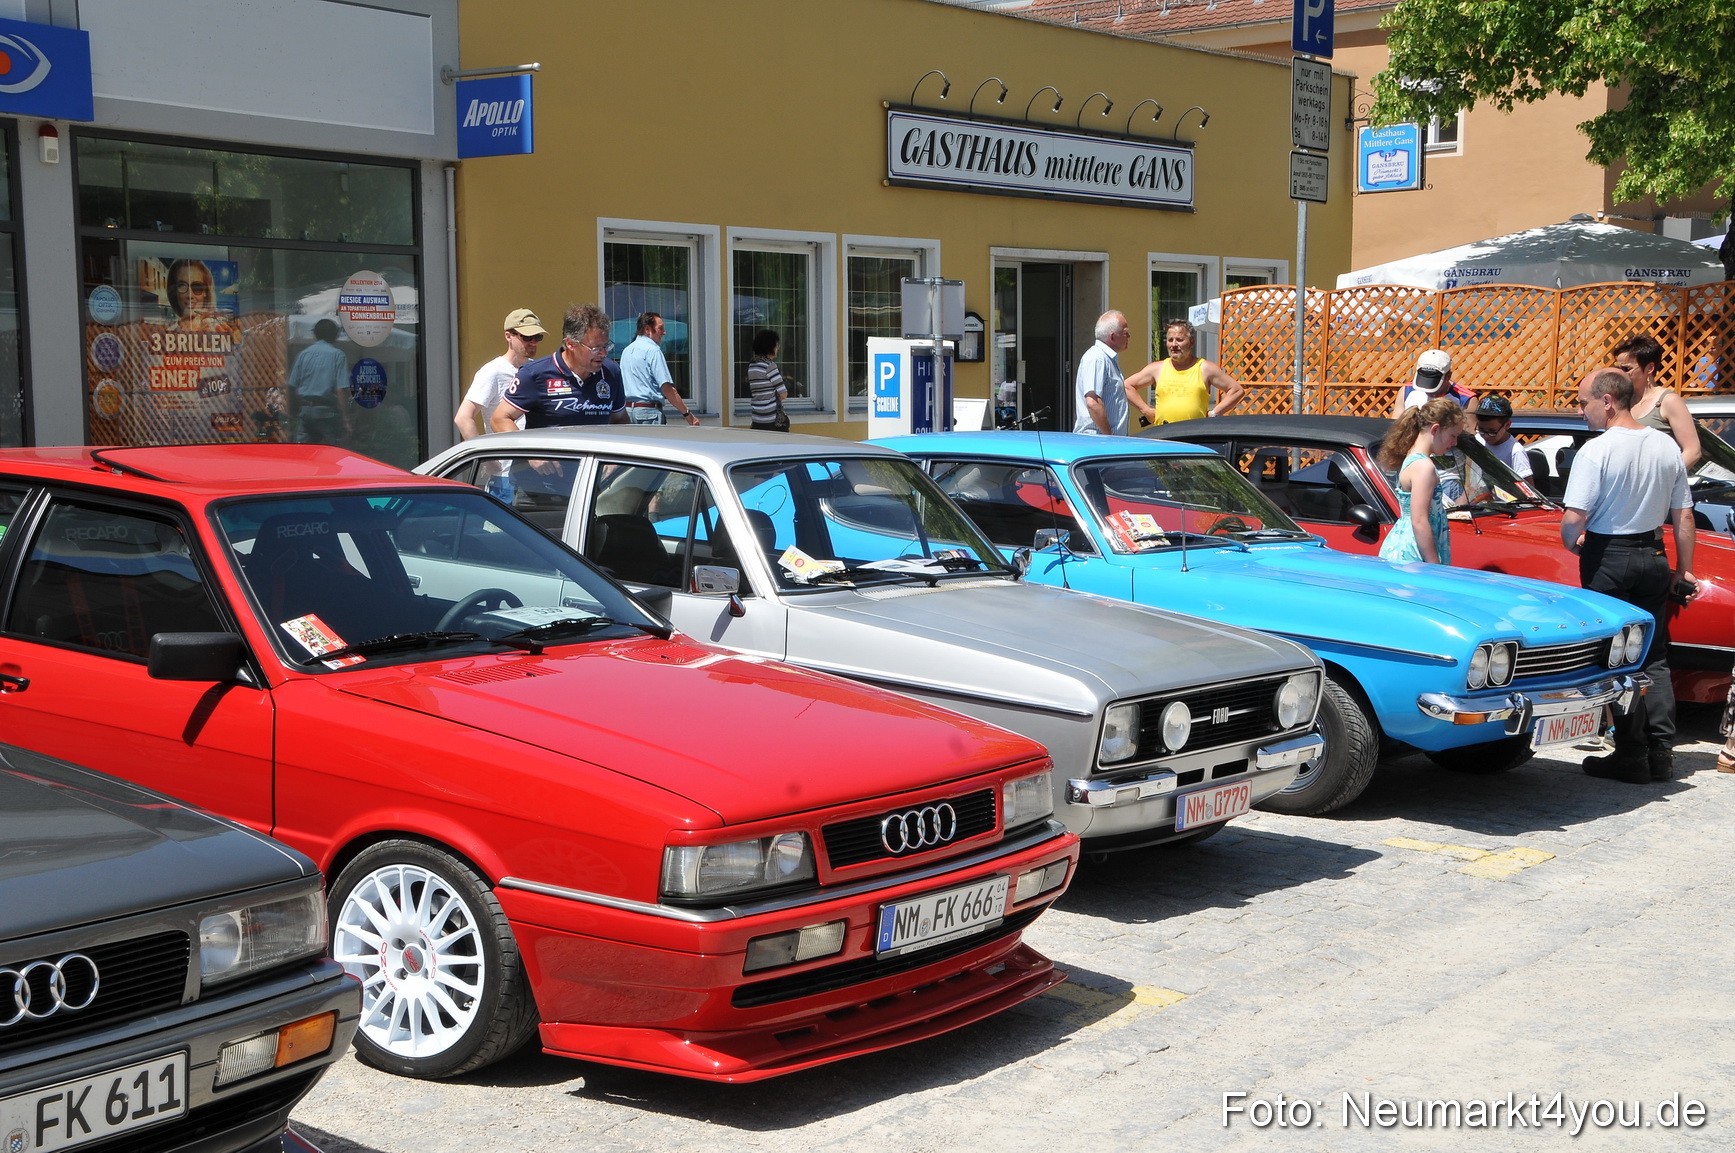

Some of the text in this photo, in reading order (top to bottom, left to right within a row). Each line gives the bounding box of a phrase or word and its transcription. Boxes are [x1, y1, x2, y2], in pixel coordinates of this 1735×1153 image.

[1303, 0, 1325, 41] P
[1301, 67, 1324, 81] nur mit
[1295, 78, 1328, 97] Parkschein
[1298, 95, 1325, 112] werktags
[463, 99, 524, 127] APOLLO
[491, 126, 518, 137] OPTIK
[1294, 127, 1301, 139] Sa
[1372, 129, 1405, 138] Gasthaus
[1364, 140, 1392, 148] Mittlere
[899, 127, 1187, 193] GASTHAUS mittlere GANS
[1443, 268, 1502, 277] GANSBRÄU
[1625, 268, 1691, 278] GANSBRÄU
[340, 296, 388, 304] RIESIGE AUSWAHL
[351, 312, 395, 320] SONNENBRILLEN
[151, 333, 232, 352] 3 BRILLEN
[166, 356, 222, 366] ZUM PREIS VON
[359, 365, 377, 374] AZUBIS
[880, 361, 896, 391] P
[151, 369, 198, 388] EINER
[356, 375, 380, 383] GESUCHT!
[551, 397, 613, 412] Richmond
[876, 396, 898, 412] SCHEINE
[65, 525, 128, 539] RECARO
[1548, 718, 1566, 741] NM
[1570, 712, 1594, 737] 0756
[1186, 795, 1206, 824] NM
[1214, 785, 1248, 817] 0779
[883, 885, 994, 942] D NM FK 666
[35, 1085, 93, 1148] FK
[105, 1063, 181, 1126] 611
